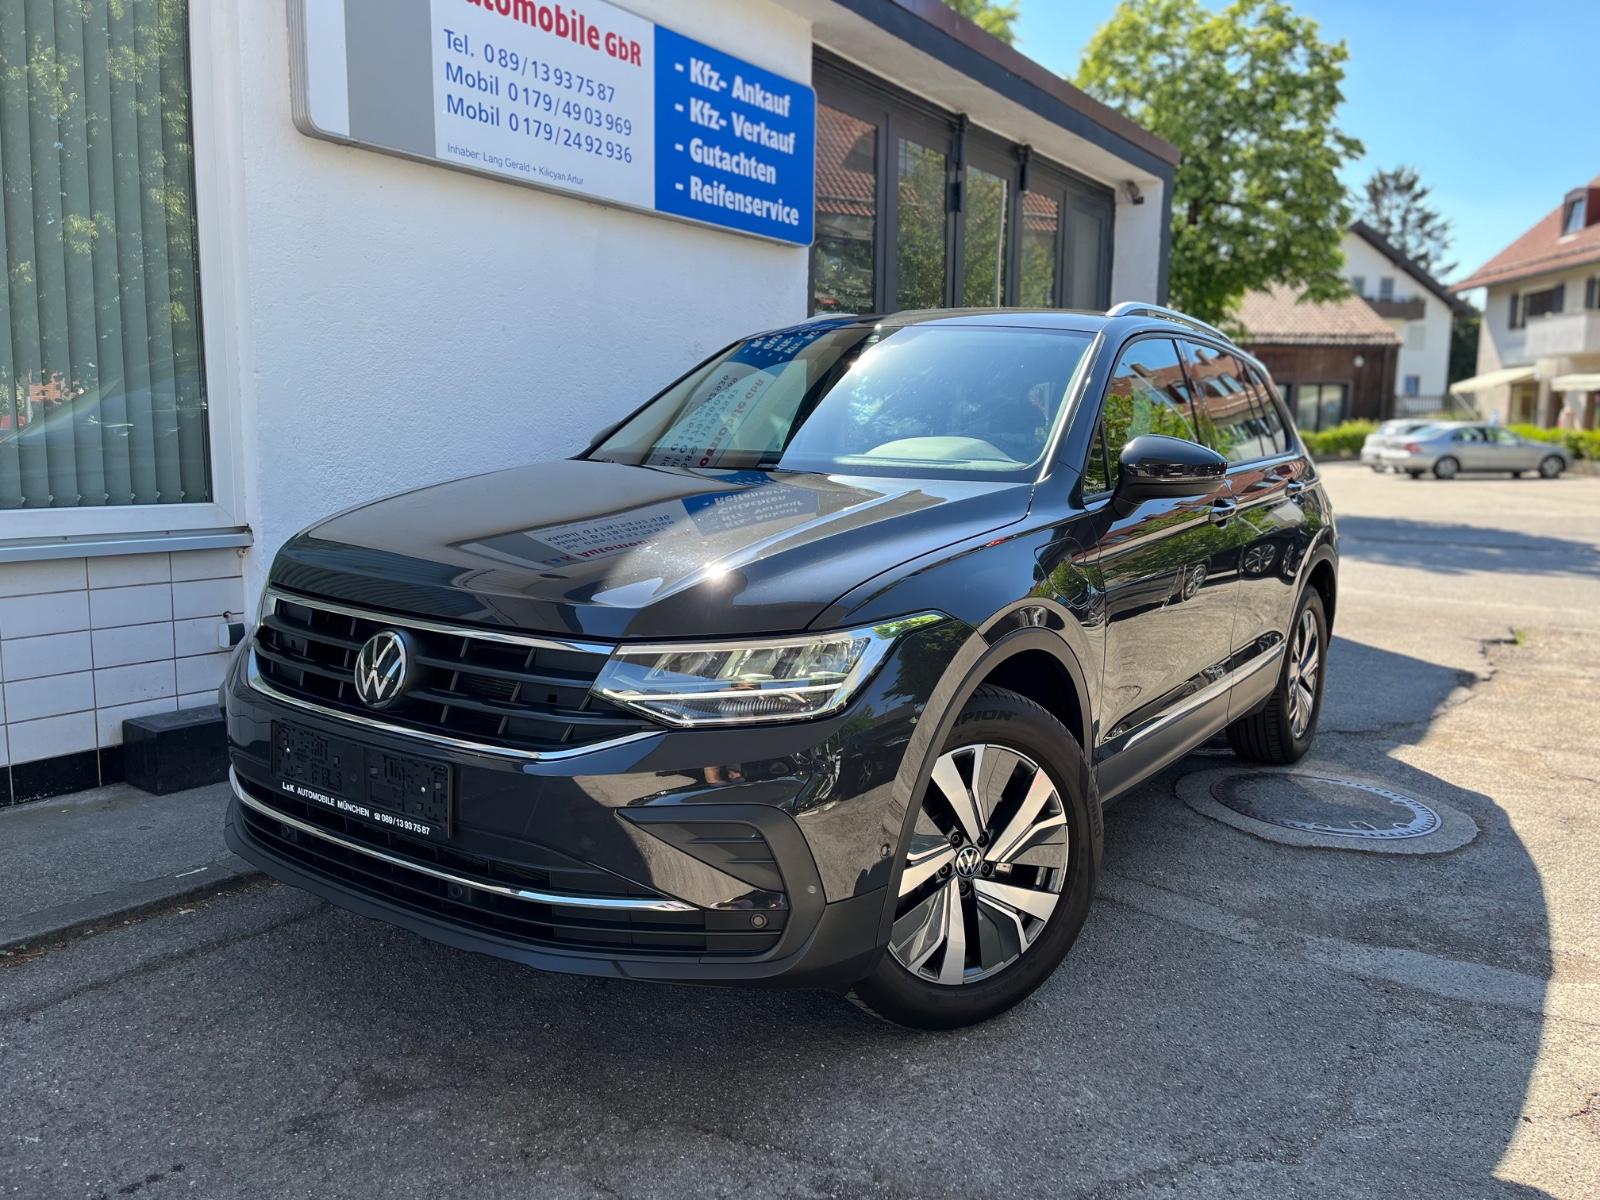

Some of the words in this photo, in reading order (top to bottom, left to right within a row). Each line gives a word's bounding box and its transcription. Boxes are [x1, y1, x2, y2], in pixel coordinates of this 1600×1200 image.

[444, 29, 474, 57] Tel.
[605, 32, 641, 67] GbR
[445, 62, 499, 96] Mobil
[446, 94, 500, 126] Mobil
[731, 75, 791, 118] Ankauf
[731, 112, 795, 155] Verkauf
[447, 144, 481, 160] Inhaber:
[483, 151, 503, 167] Lang
[505, 155, 530, 172] Gerald
[689, 137, 776, 185] Gutachten
[690, 175, 799, 226] Reifenservice
[297, 787, 335, 807] AUTOMOBILE
[337, 800, 370, 818] MÜNCHEN
